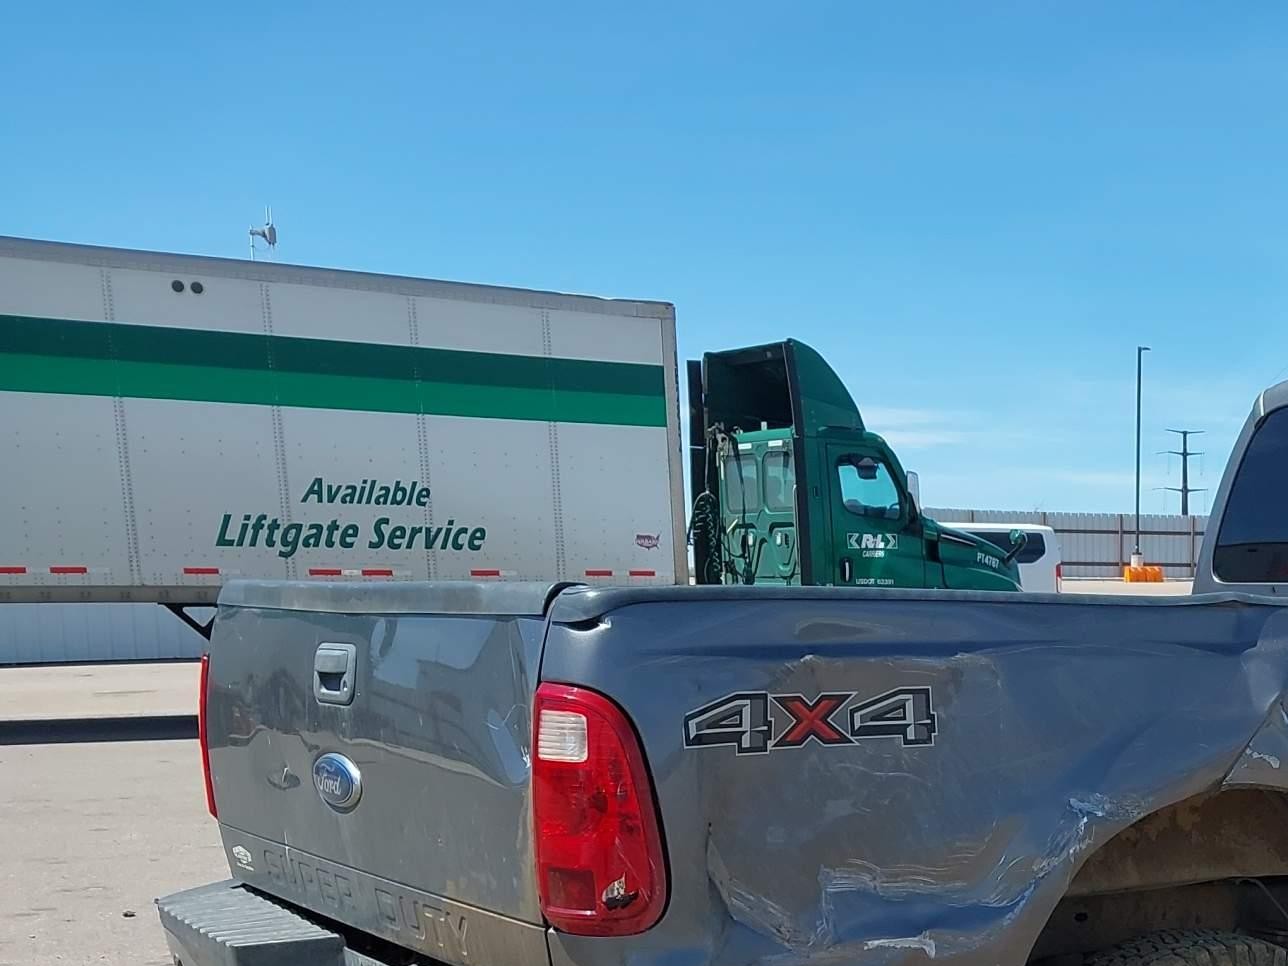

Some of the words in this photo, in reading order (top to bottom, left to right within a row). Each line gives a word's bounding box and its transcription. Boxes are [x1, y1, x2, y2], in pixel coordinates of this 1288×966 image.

[301, 477, 431, 507] Available
[216, 513, 359, 559] Liftgate
[368, 517, 487, 551] Service
[317, 763, 342, 796] Ford
[263, 850, 358, 910] SUPER
[374, 888, 469, 957] DUTY
